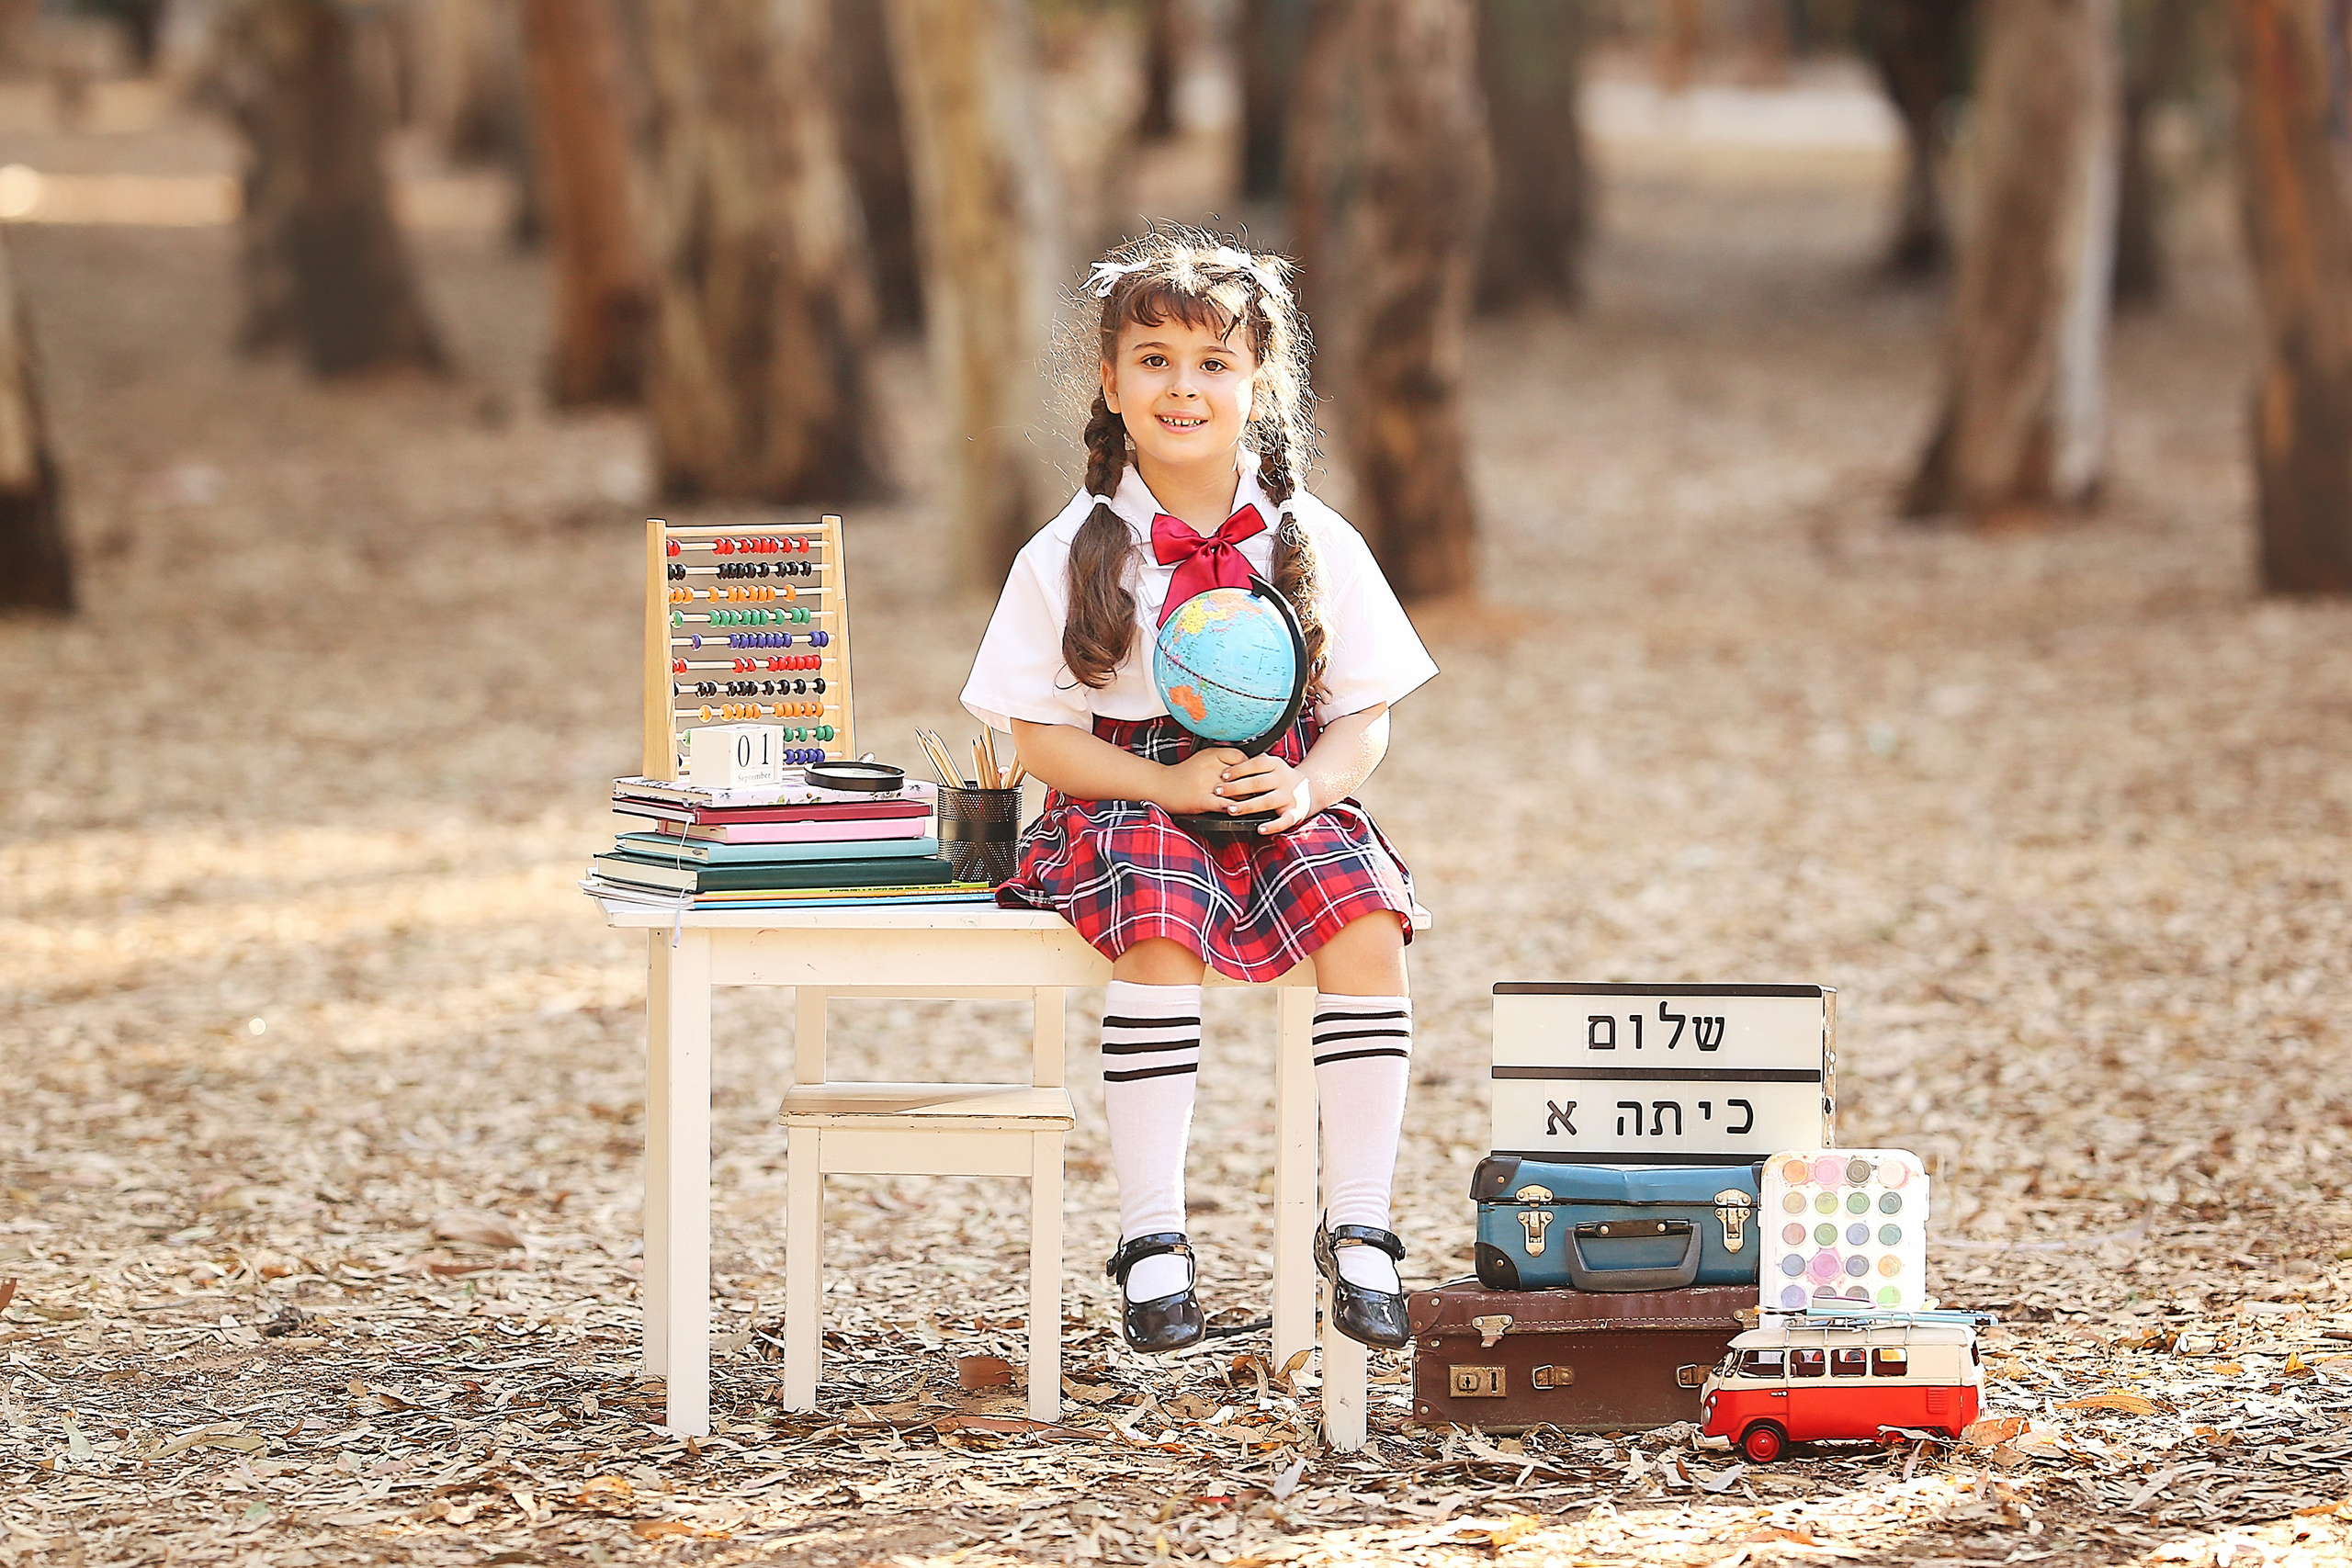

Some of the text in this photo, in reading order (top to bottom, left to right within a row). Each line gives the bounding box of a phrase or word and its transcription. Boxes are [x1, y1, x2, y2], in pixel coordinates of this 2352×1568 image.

[738, 732, 769, 767] 01
[738, 772, 770, 783] September
[1588, 1000, 1725, 1052] שלום
[1545, 1099, 1754, 1136] כיתה א
